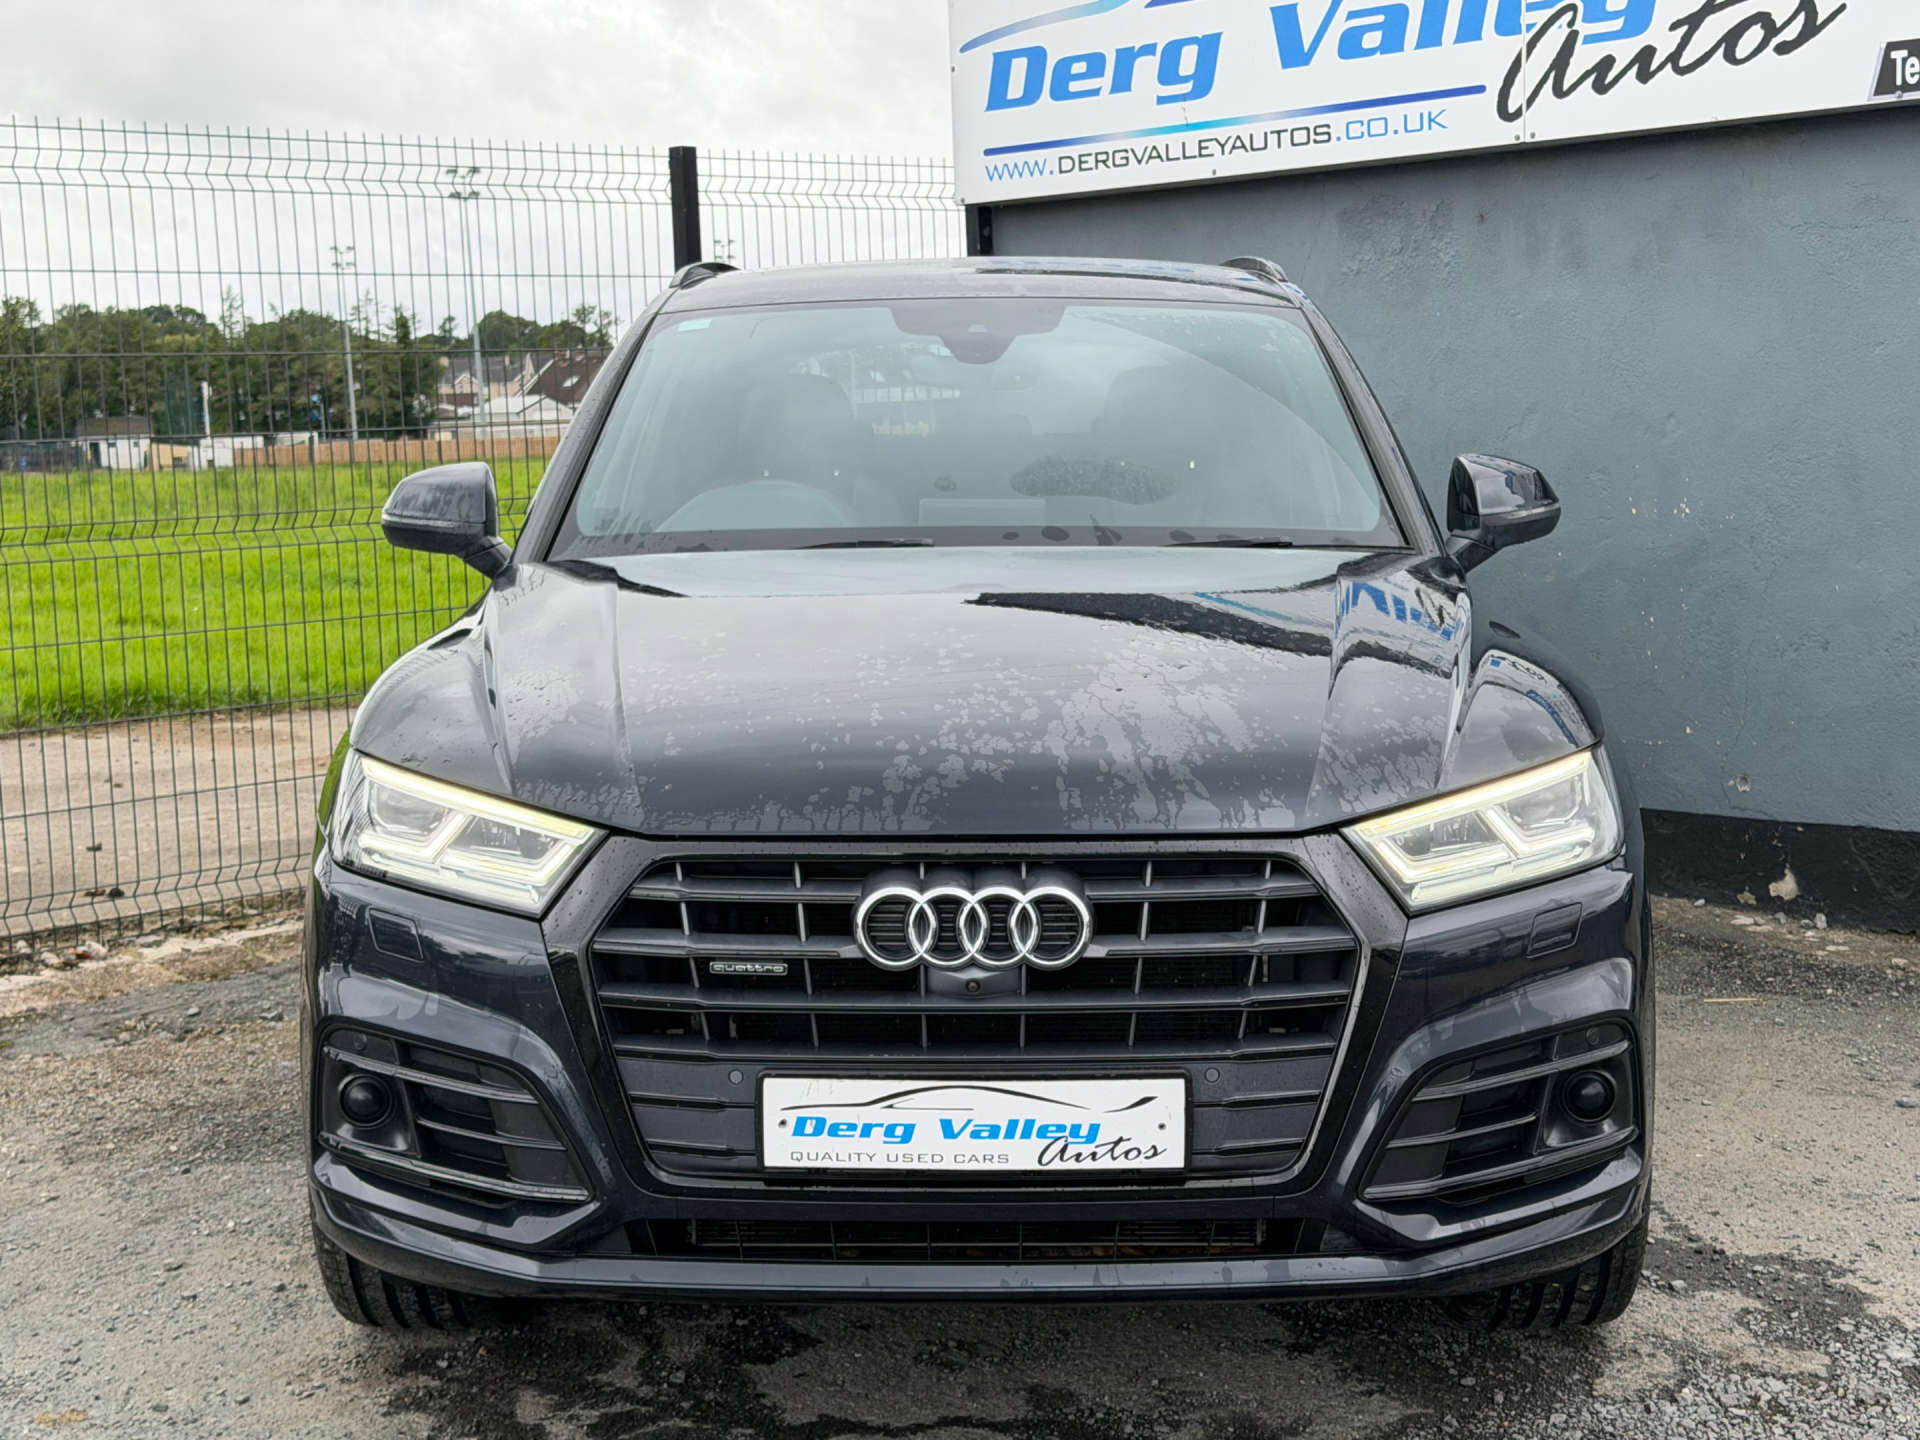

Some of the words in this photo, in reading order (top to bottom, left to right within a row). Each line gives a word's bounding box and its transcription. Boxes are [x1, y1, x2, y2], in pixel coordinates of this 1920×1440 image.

[985, 32, 1223, 112] Derg
[1496, 0, 1847, 123] Autos
[712, 963, 784, 974] quattro
[792, 1116, 916, 1145] Derg
[939, 1118, 1101, 1145] Valley
[790, 1151, 877, 1163] QUALITY
[886, 1153, 944, 1164] USED
[953, 1153, 1009, 1164] CARS
[1037, 1135, 1168, 1167] Autos
